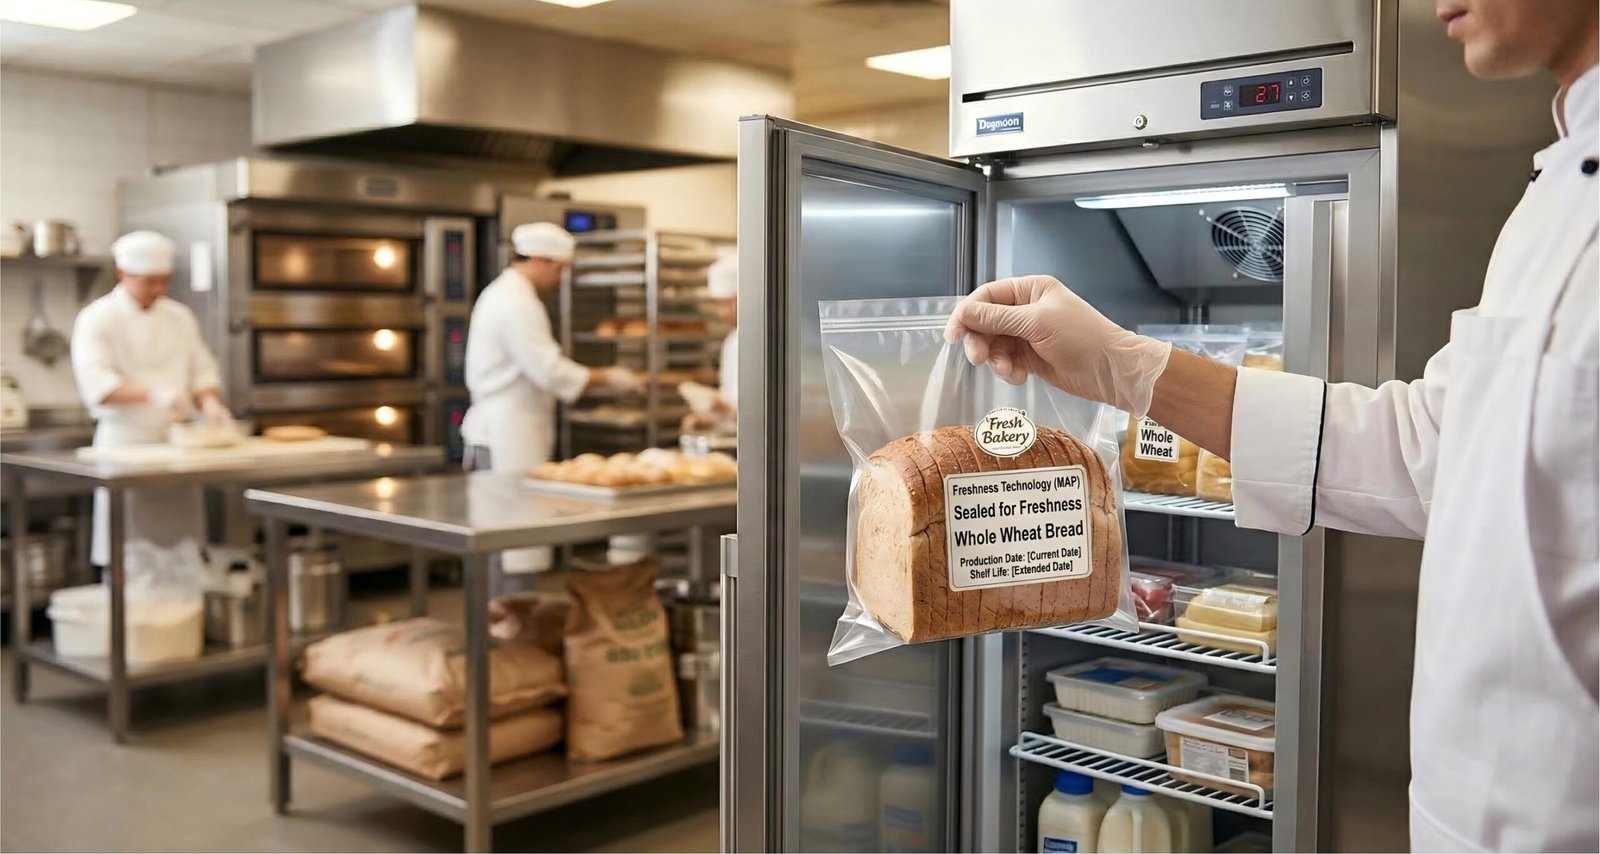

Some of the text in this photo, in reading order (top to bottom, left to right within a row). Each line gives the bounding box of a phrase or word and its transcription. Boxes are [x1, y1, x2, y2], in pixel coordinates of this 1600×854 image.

[1256, 84, 1279, 103] 27
[989, 416, 1024, 430] Fresh
[981, 430, 1030, 446] Bakery
[1141, 428, 1173, 443] Whole
[1140, 442, 1173, 458] Wheat
[952, 475, 1081, 496] Freshness Technology (MAP)
[954, 498, 1082, 520] Sealed for Freshness
[954, 520, 1084, 547] Whole Wheat Bread
[960, 546, 1082, 567] Production Date: [Current Date]
[970, 560, 1073, 579] Shelf Life: [Extended Date]
